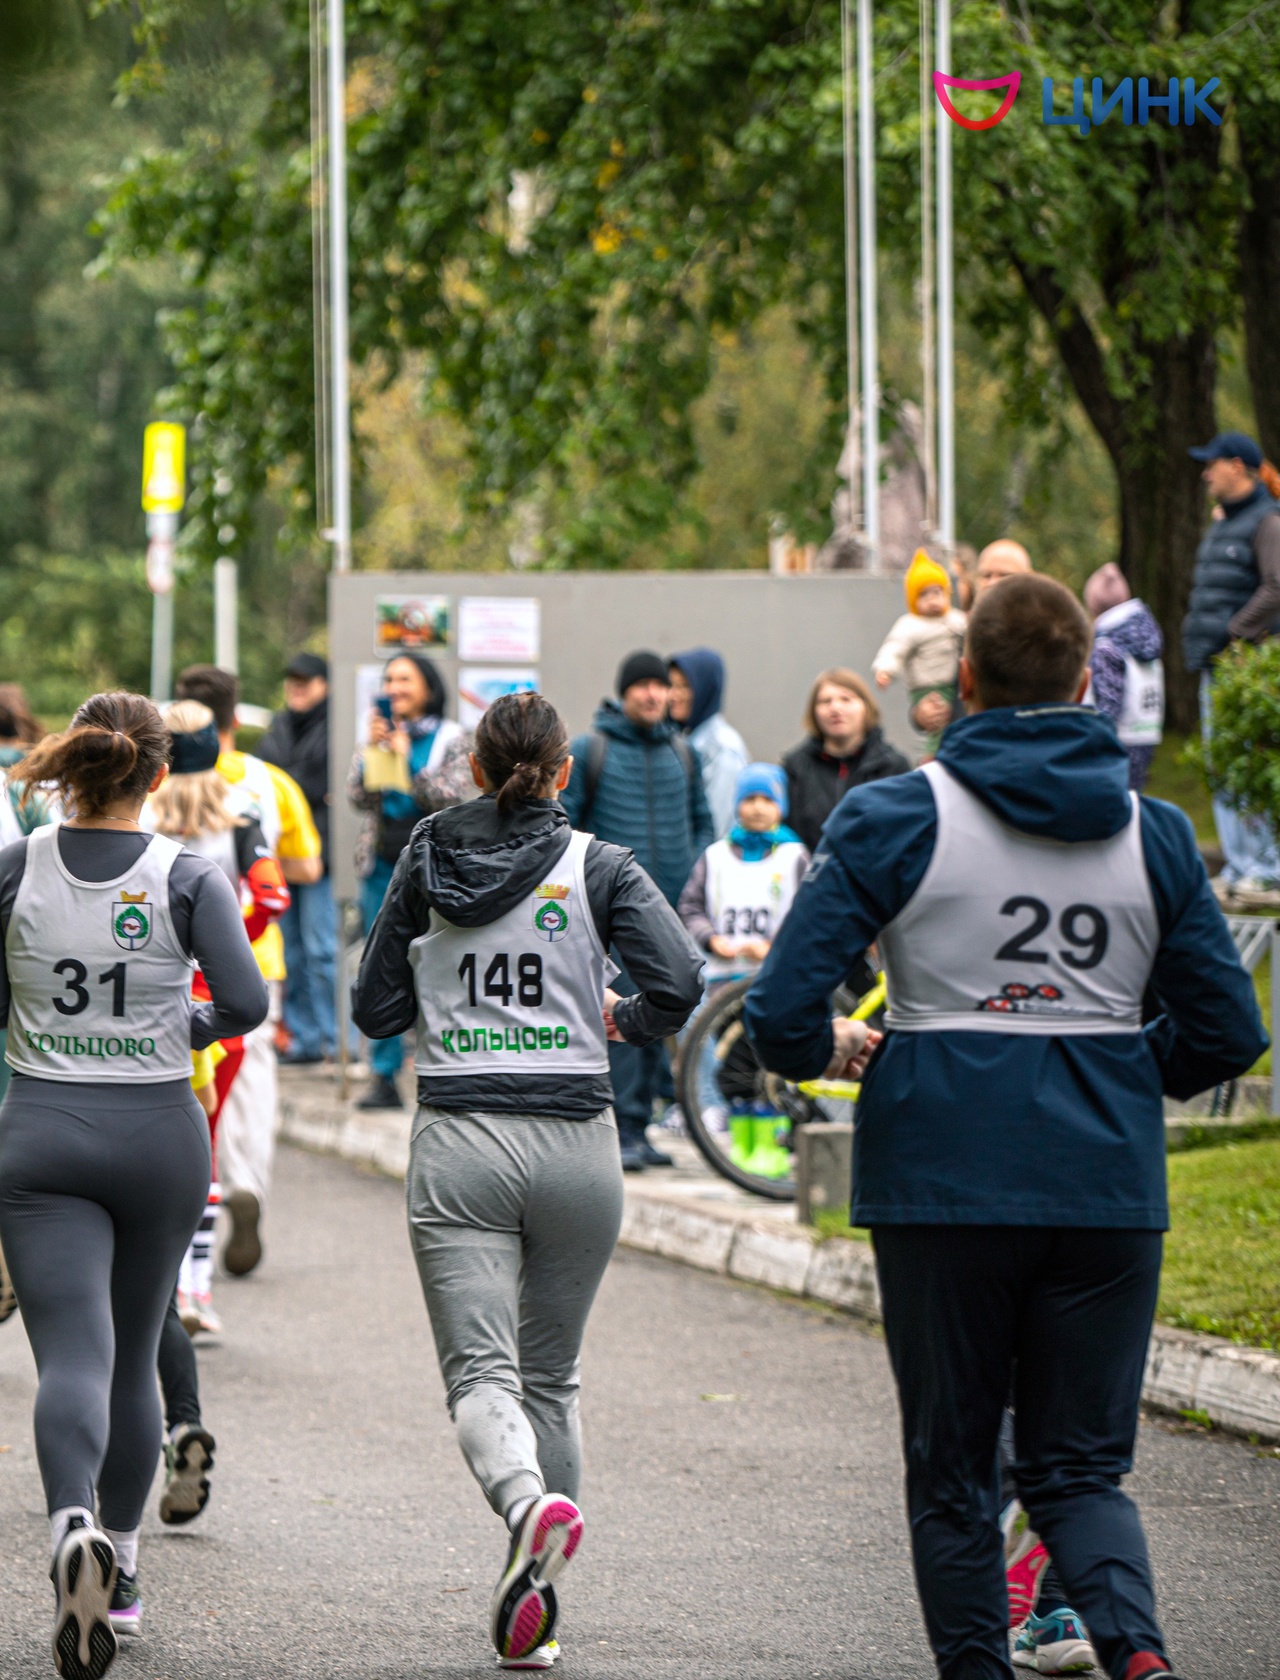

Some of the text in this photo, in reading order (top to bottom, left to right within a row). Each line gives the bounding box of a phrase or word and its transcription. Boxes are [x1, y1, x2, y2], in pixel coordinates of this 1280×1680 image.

[994, 895, 1109, 970] 29
[51, 958, 126, 1017] 31
[457, 952, 543, 1008] 148
[24, 1029, 156, 1060] КОЛЬЦОВО
[440, 1025, 569, 1054] КОЛЬЦОВО
